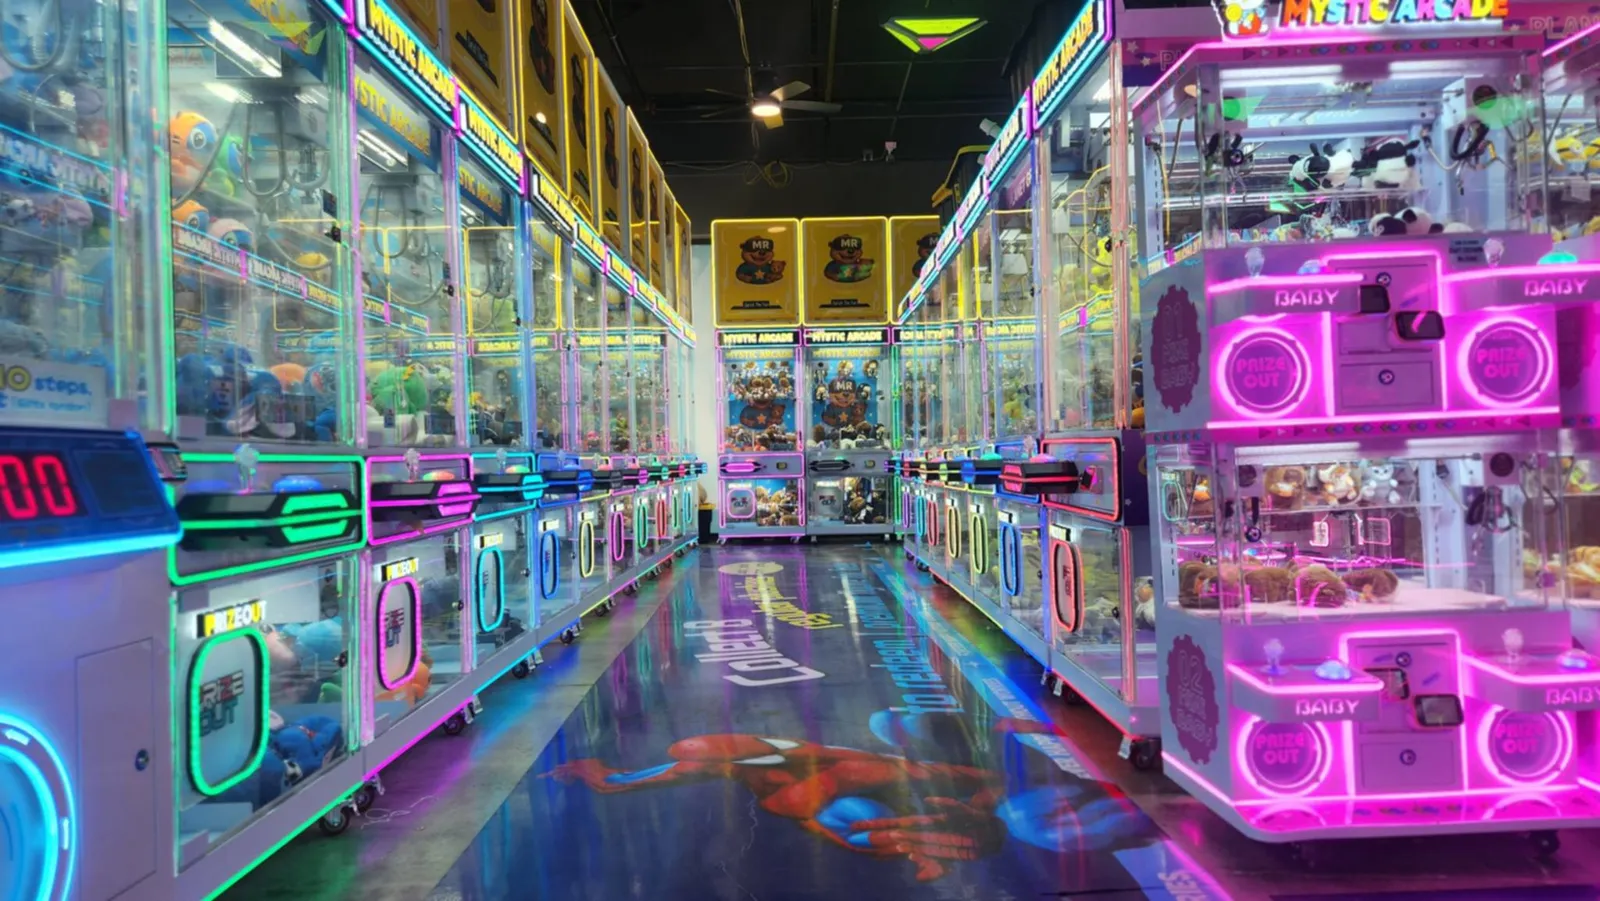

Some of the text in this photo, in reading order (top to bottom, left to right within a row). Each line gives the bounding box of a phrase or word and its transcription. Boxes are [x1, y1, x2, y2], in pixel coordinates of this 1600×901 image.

[1279, 0, 1509, 27] MYSTIC ARCADE
[369, 0, 417, 69] MYSTIC
[752, 239, 770, 250] MR
[841, 237, 859, 248] MR
[1524, 279, 1589, 296] BABY
[1275, 289, 1340, 307] BABY
[723, 332, 794, 344] MYSTIC ARCADE
[812, 331, 883, 343] MYSTIC ARCADE
[1477, 346, 1527, 364] PRIZE
[1236, 356, 1287, 374] PRIZE
[1484, 362, 1521, 380] OUT
[836, 380, 853, 391] MR
[1243, 372, 1281, 390] OUT
[684, 630, 825, 686] Collect
[869, 640, 948, 689] redeem
[1296, 700, 1360, 715] BABY
[1495, 723, 1546, 740] PRIZE
[1256, 731, 1305, 750] PRIZE
[1502, 739, 1539, 754] OUT
[1264, 748, 1300, 765] OUT
